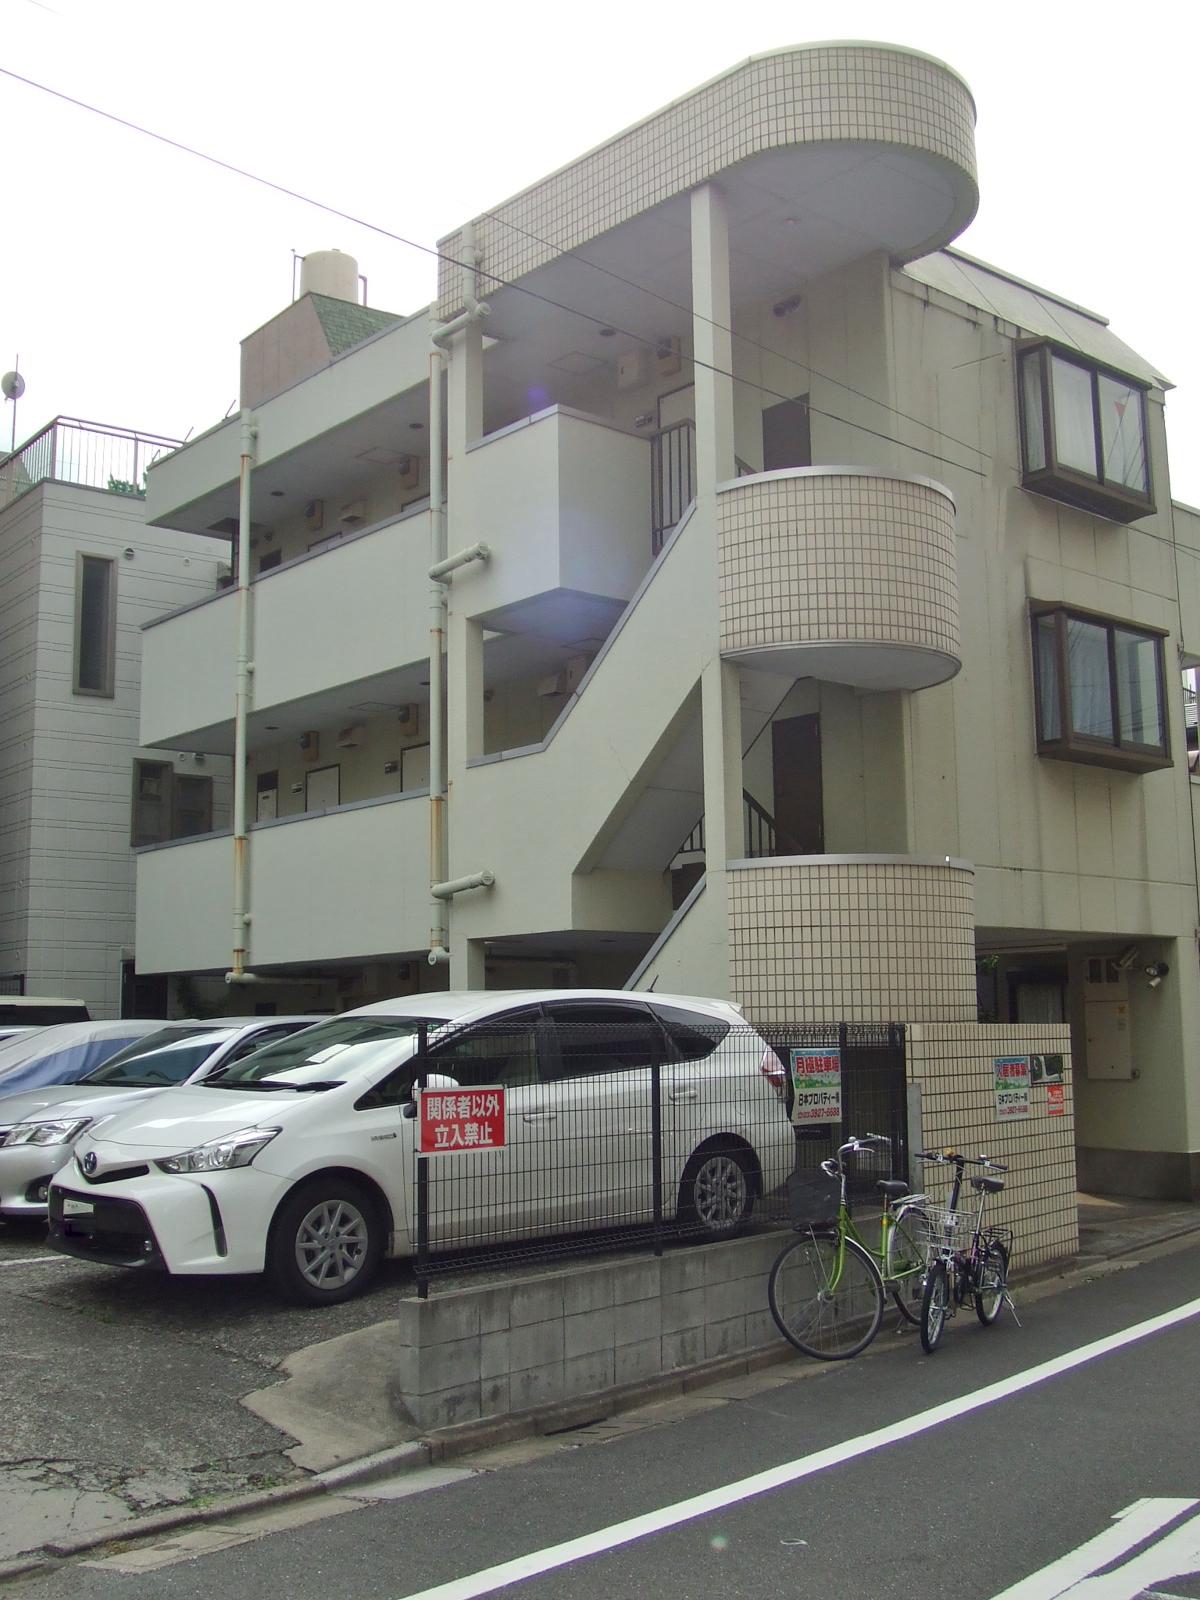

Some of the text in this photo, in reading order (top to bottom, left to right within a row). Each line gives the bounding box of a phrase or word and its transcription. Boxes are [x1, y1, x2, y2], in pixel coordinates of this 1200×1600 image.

[795, 1055, 840, 1074] 月極駐車場
[426, 1093, 500, 1121] 関係者以外
[434, 1121, 493, 1148] 立入禁止
